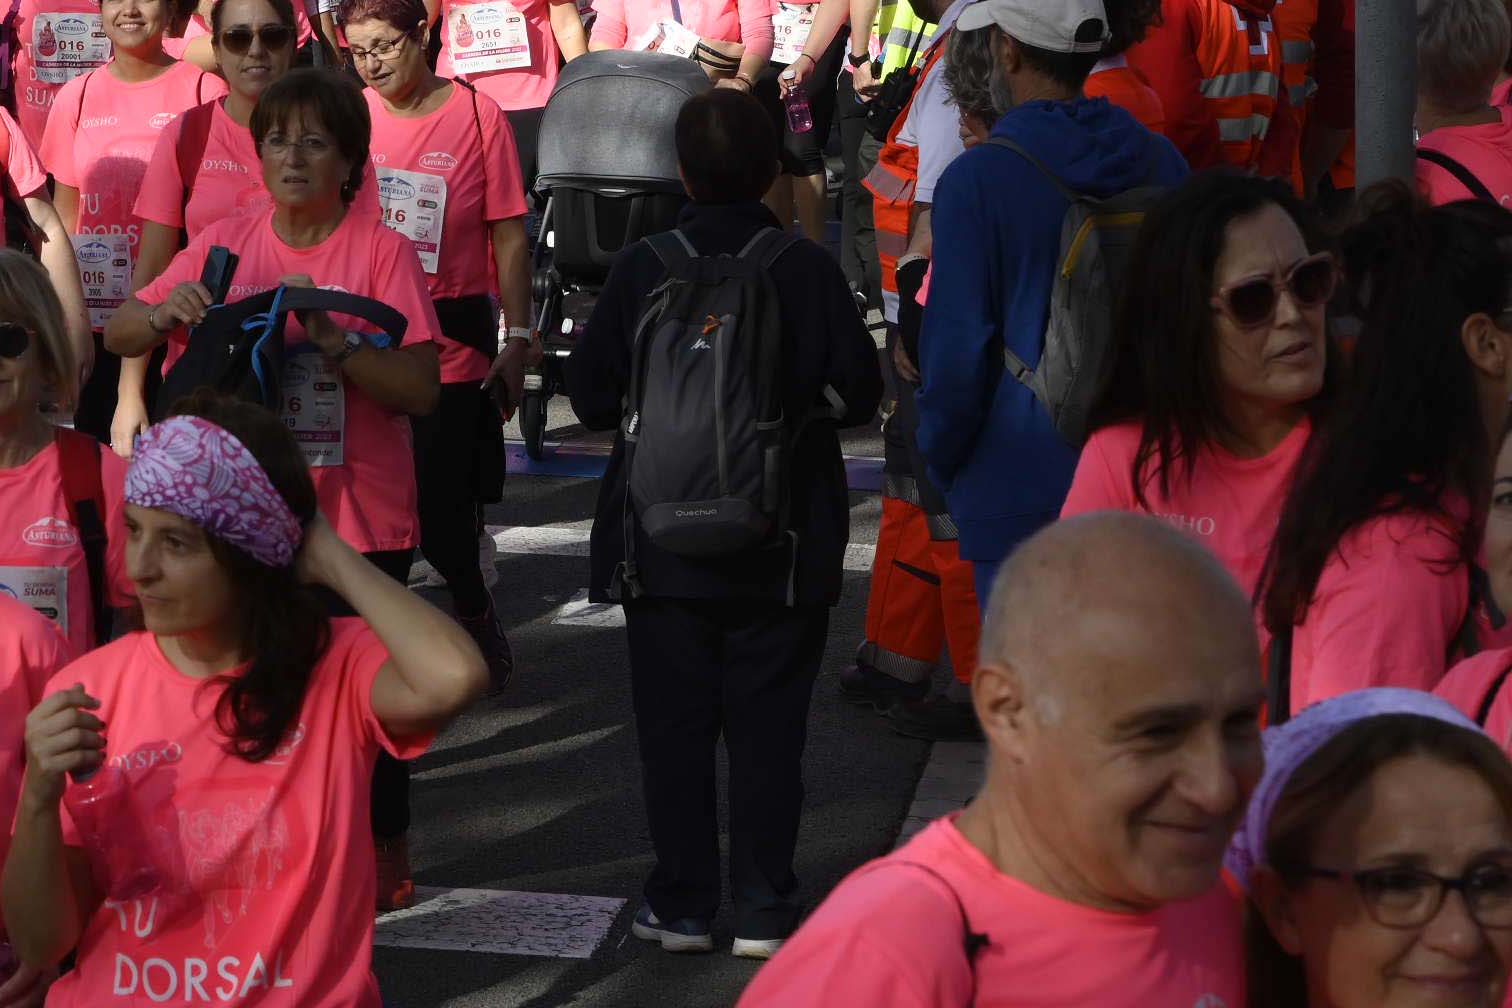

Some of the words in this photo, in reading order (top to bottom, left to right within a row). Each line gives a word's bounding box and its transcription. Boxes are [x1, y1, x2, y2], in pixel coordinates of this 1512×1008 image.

[476, 29, 501, 39] 016
[778, 25, 792, 34] 16
[58, 40, 85, 51] 016
[82, 117, 118, 129] OYSHO
[203, 159, 248, 174] OYSHO
[380, 185, 411, 195] STURIANA
[385, 208, 406, 223] 16
[82, 271, 105, 284] 016
[675, 507, 718, 518] Quechua
[24, 588, 57, 596] SUMA
[106, 899, 160, 940] TU
[113, 951, 294, 1003] DORSAL
